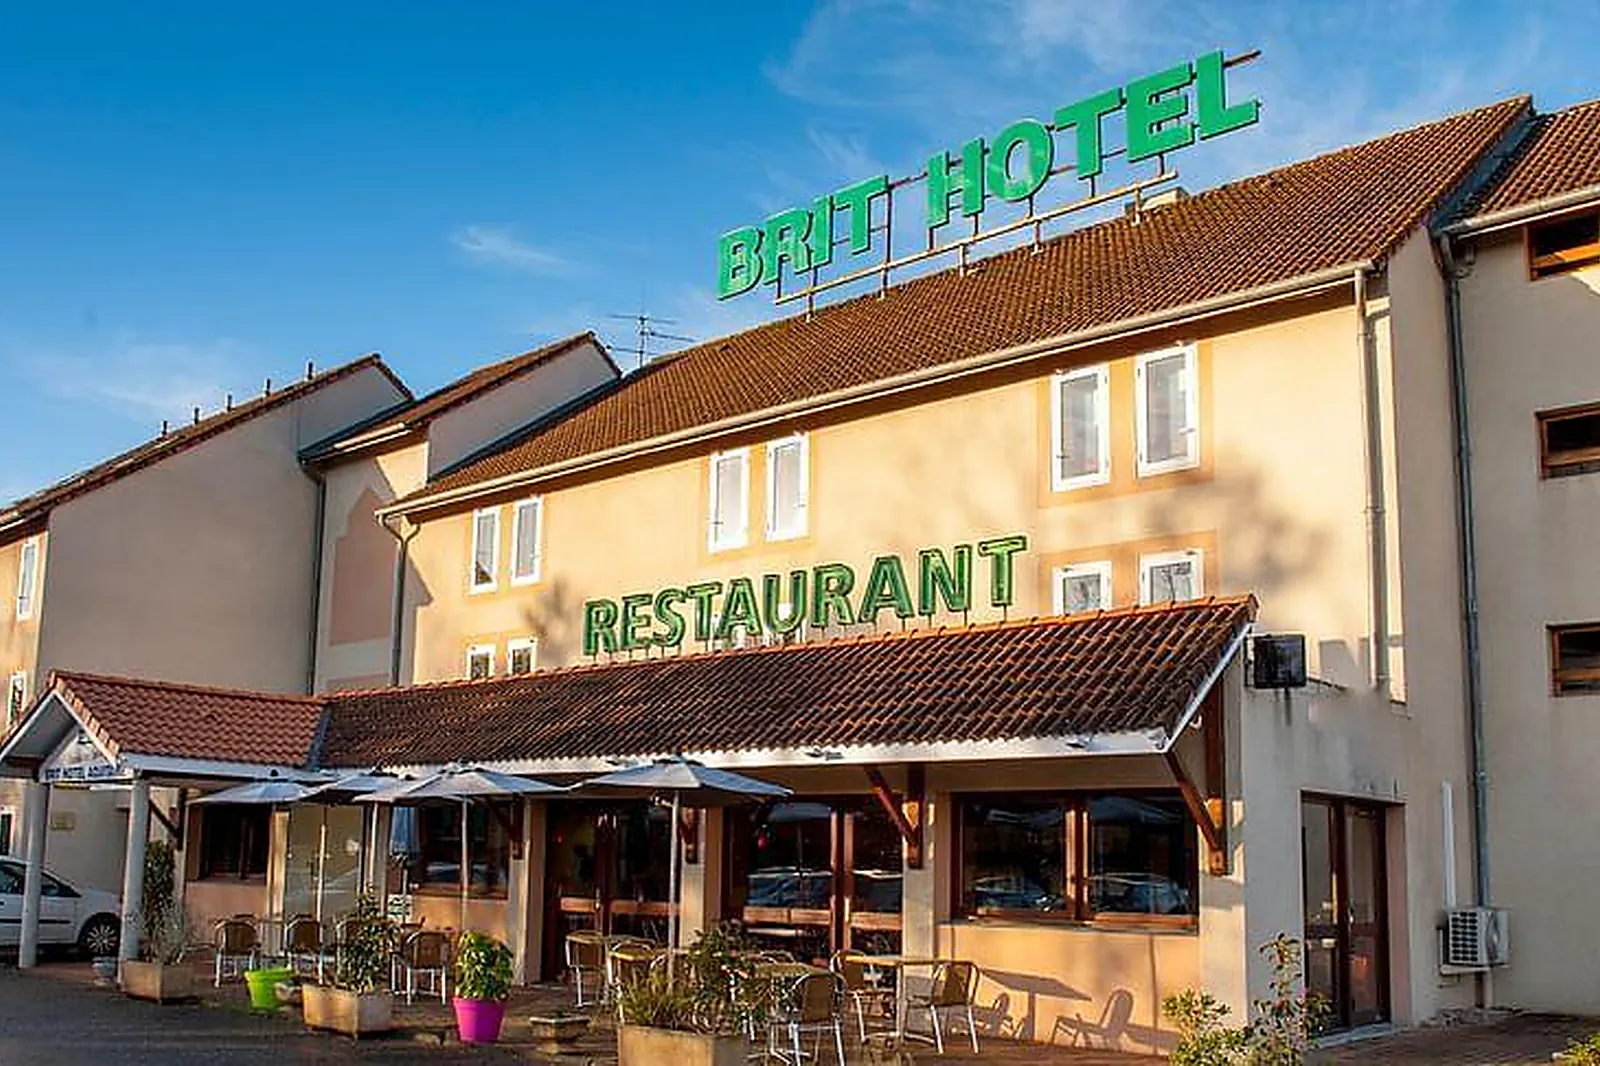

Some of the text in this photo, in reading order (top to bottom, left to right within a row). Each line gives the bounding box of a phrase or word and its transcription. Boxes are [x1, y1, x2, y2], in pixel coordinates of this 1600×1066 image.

[717, 50, 1260, 300] BRIT HOTEL
[583, 535, 1027, 657] RESTAURANT
